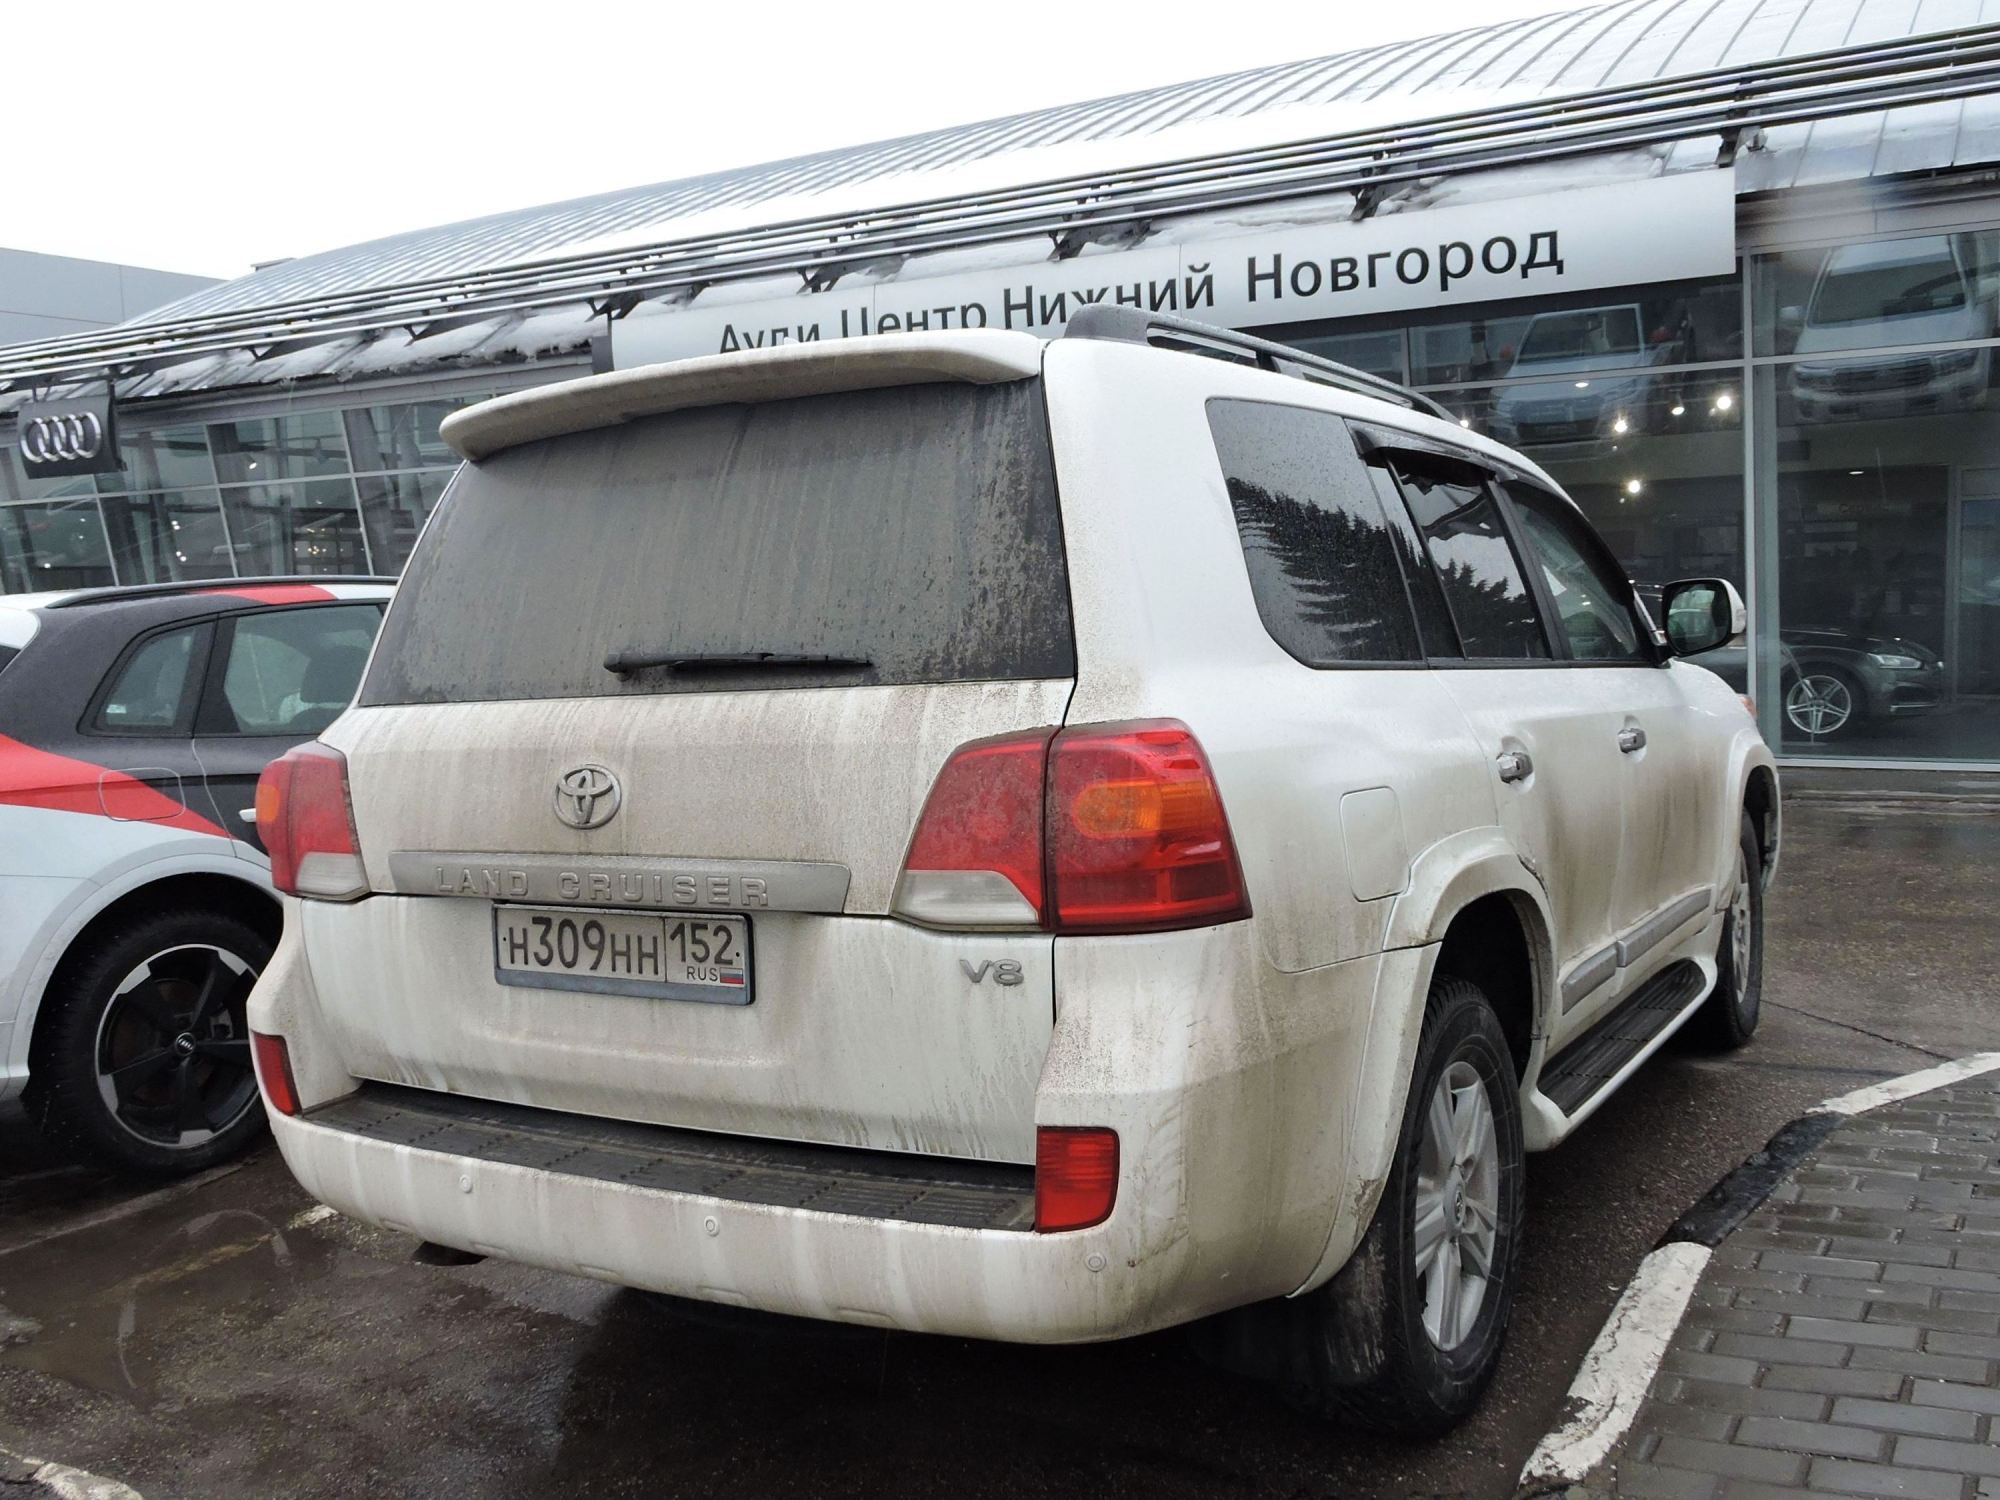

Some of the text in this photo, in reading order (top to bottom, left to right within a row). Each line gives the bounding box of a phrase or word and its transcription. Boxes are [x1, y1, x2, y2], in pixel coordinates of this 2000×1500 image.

[841, 299, 988, 338] Центр
[1247, 230, 1564, 302] Новгород
[435, 867, 769, 906] LAND CRUISER
[669, 923, 734, 965] 152
[686, 966, 719, 982] RUS
[959, 958, 1024, 986] V8
